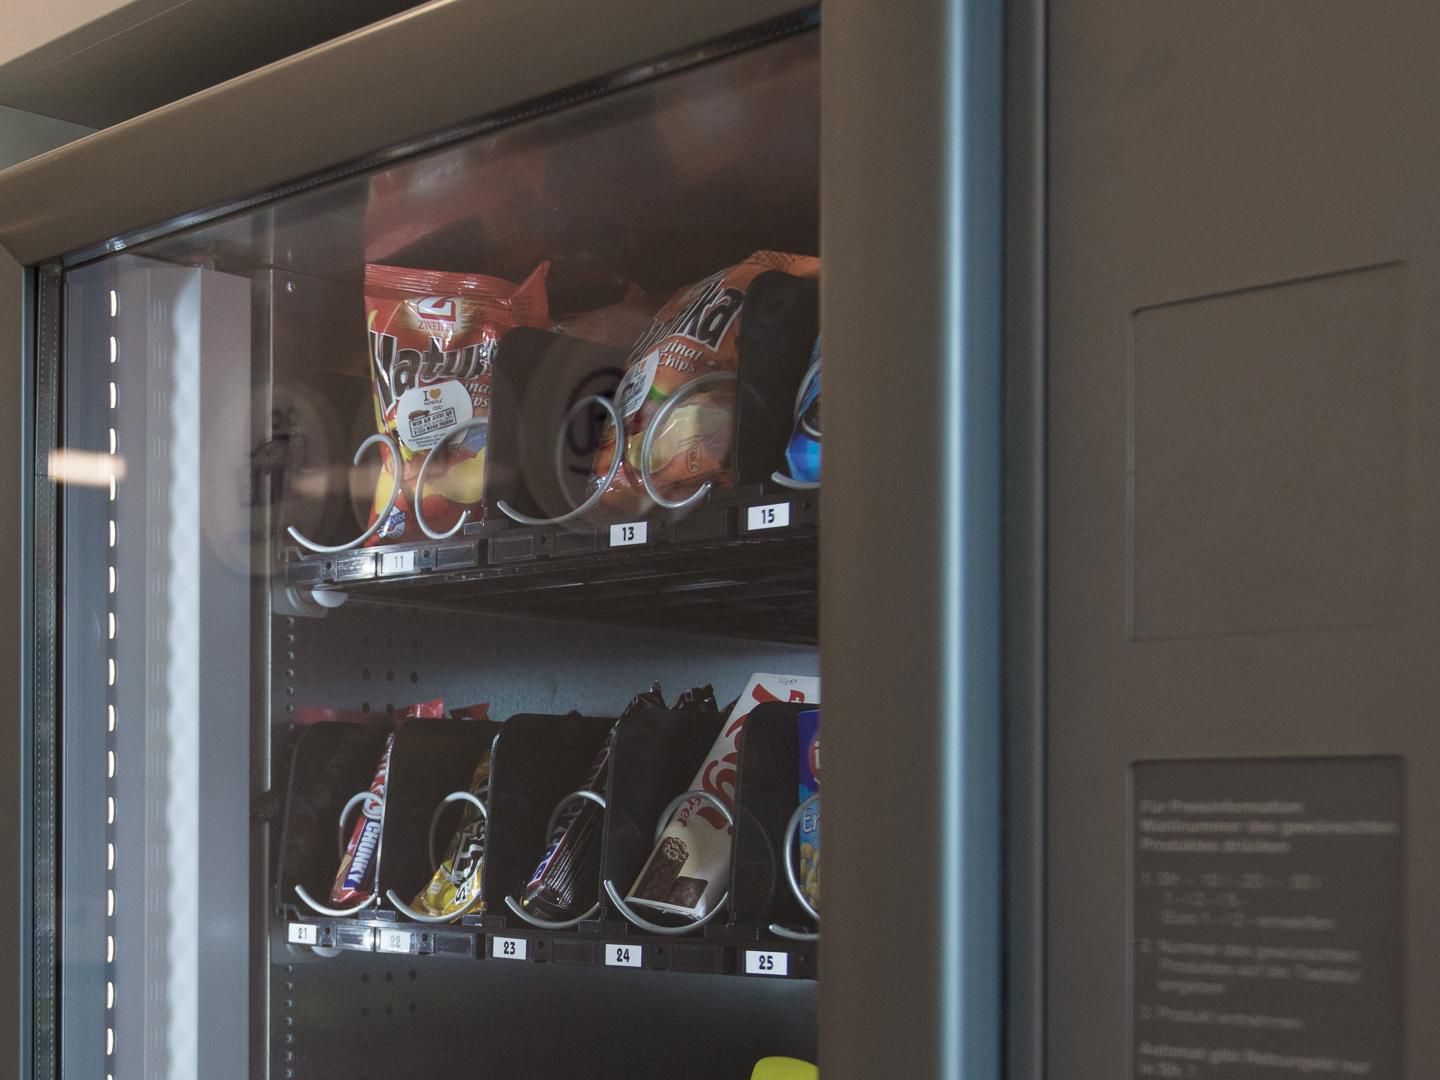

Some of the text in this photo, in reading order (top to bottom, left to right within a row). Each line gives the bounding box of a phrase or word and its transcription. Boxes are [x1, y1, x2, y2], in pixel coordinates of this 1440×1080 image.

[761, 508, 775, 524] 15
[622, 526, 634, 541] 13
[394, 555, 404, 569] 11
[347, 820, 381, 885] CHUNKY
[298, 927, 308, 939] 21
[390, 935, 401, 948] 22
[503, 940, 516, 955] 23
[616, 948, 630, 963] 24
[758, 955, 774, 970] 25
